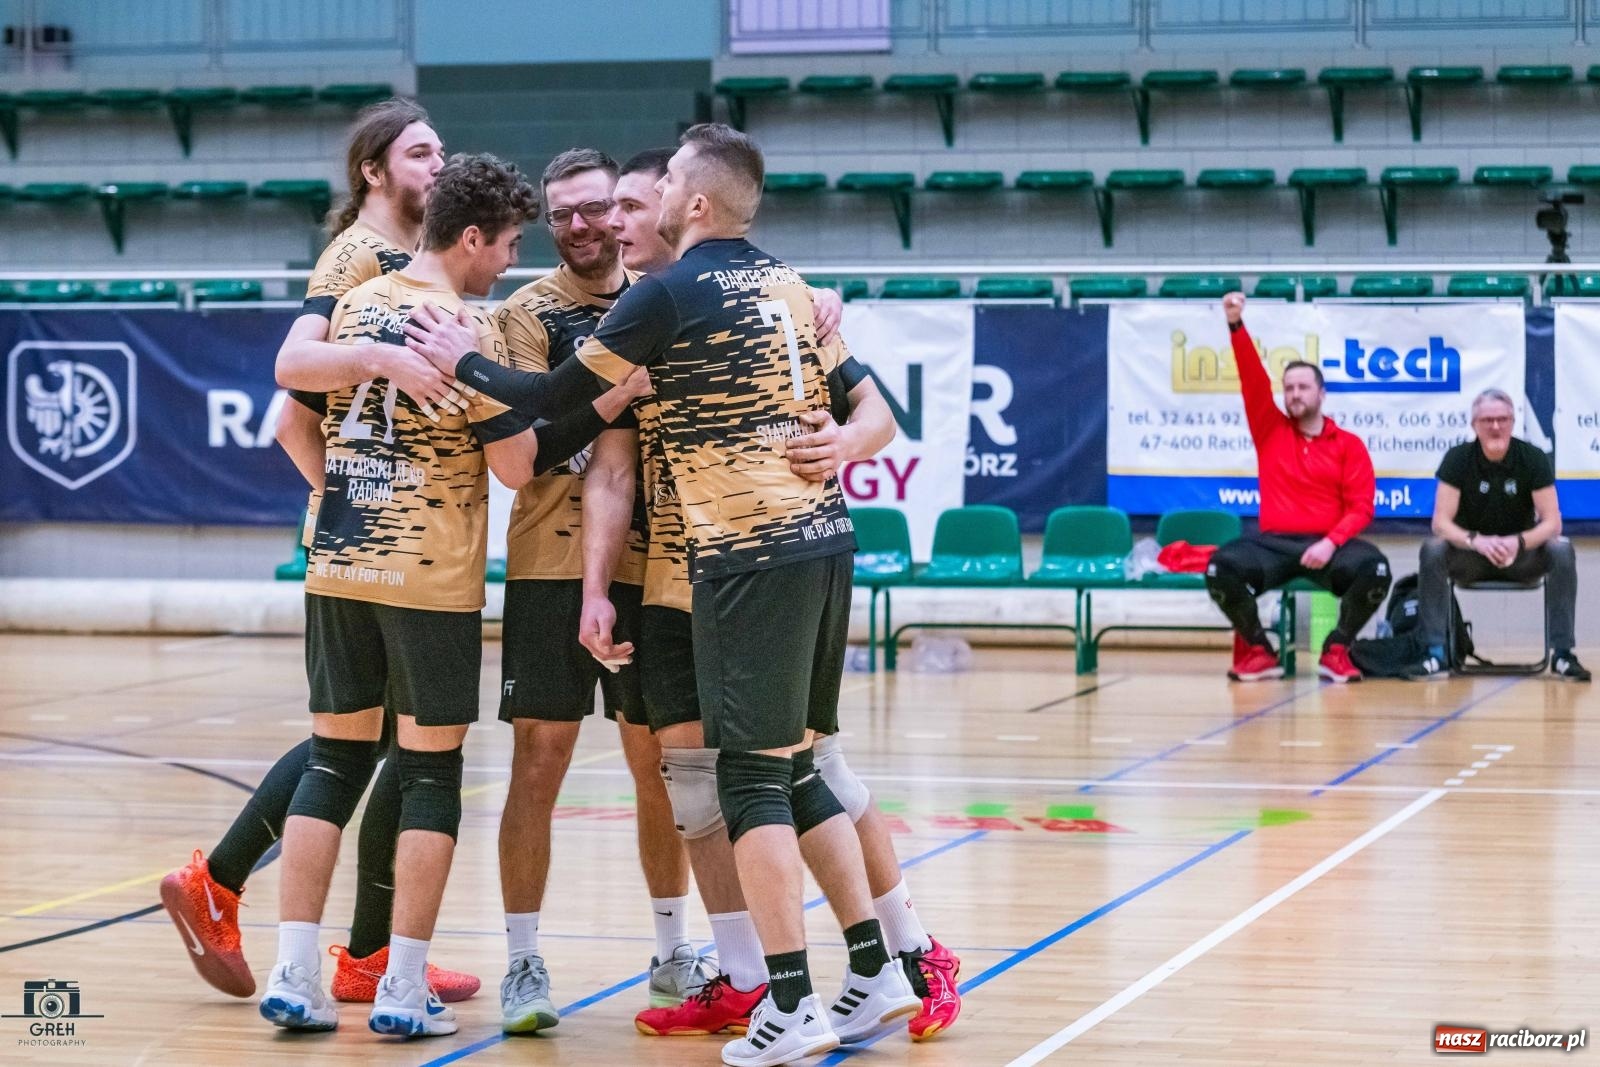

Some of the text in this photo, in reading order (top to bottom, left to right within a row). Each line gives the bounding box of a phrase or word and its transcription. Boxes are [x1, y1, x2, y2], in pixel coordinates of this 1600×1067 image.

[756, 299, 805, 402] 7
[1160, 411, 1179, 426] 32
[1185, 411, 1216, 426] 414
[1221, 411, 1242, 426] 92
[1398, 411, 1431, 427] 606
[1437, 411, 1468, 426] 363
[1140, 434, 1204, 451] 47-400
[843, 458, 921, 502] GY
[802, 525, 818, 541] WE
[815, 522, 836, 538] PLAY
[315, 561, 405, 586] WE PLAY FOR FUN
